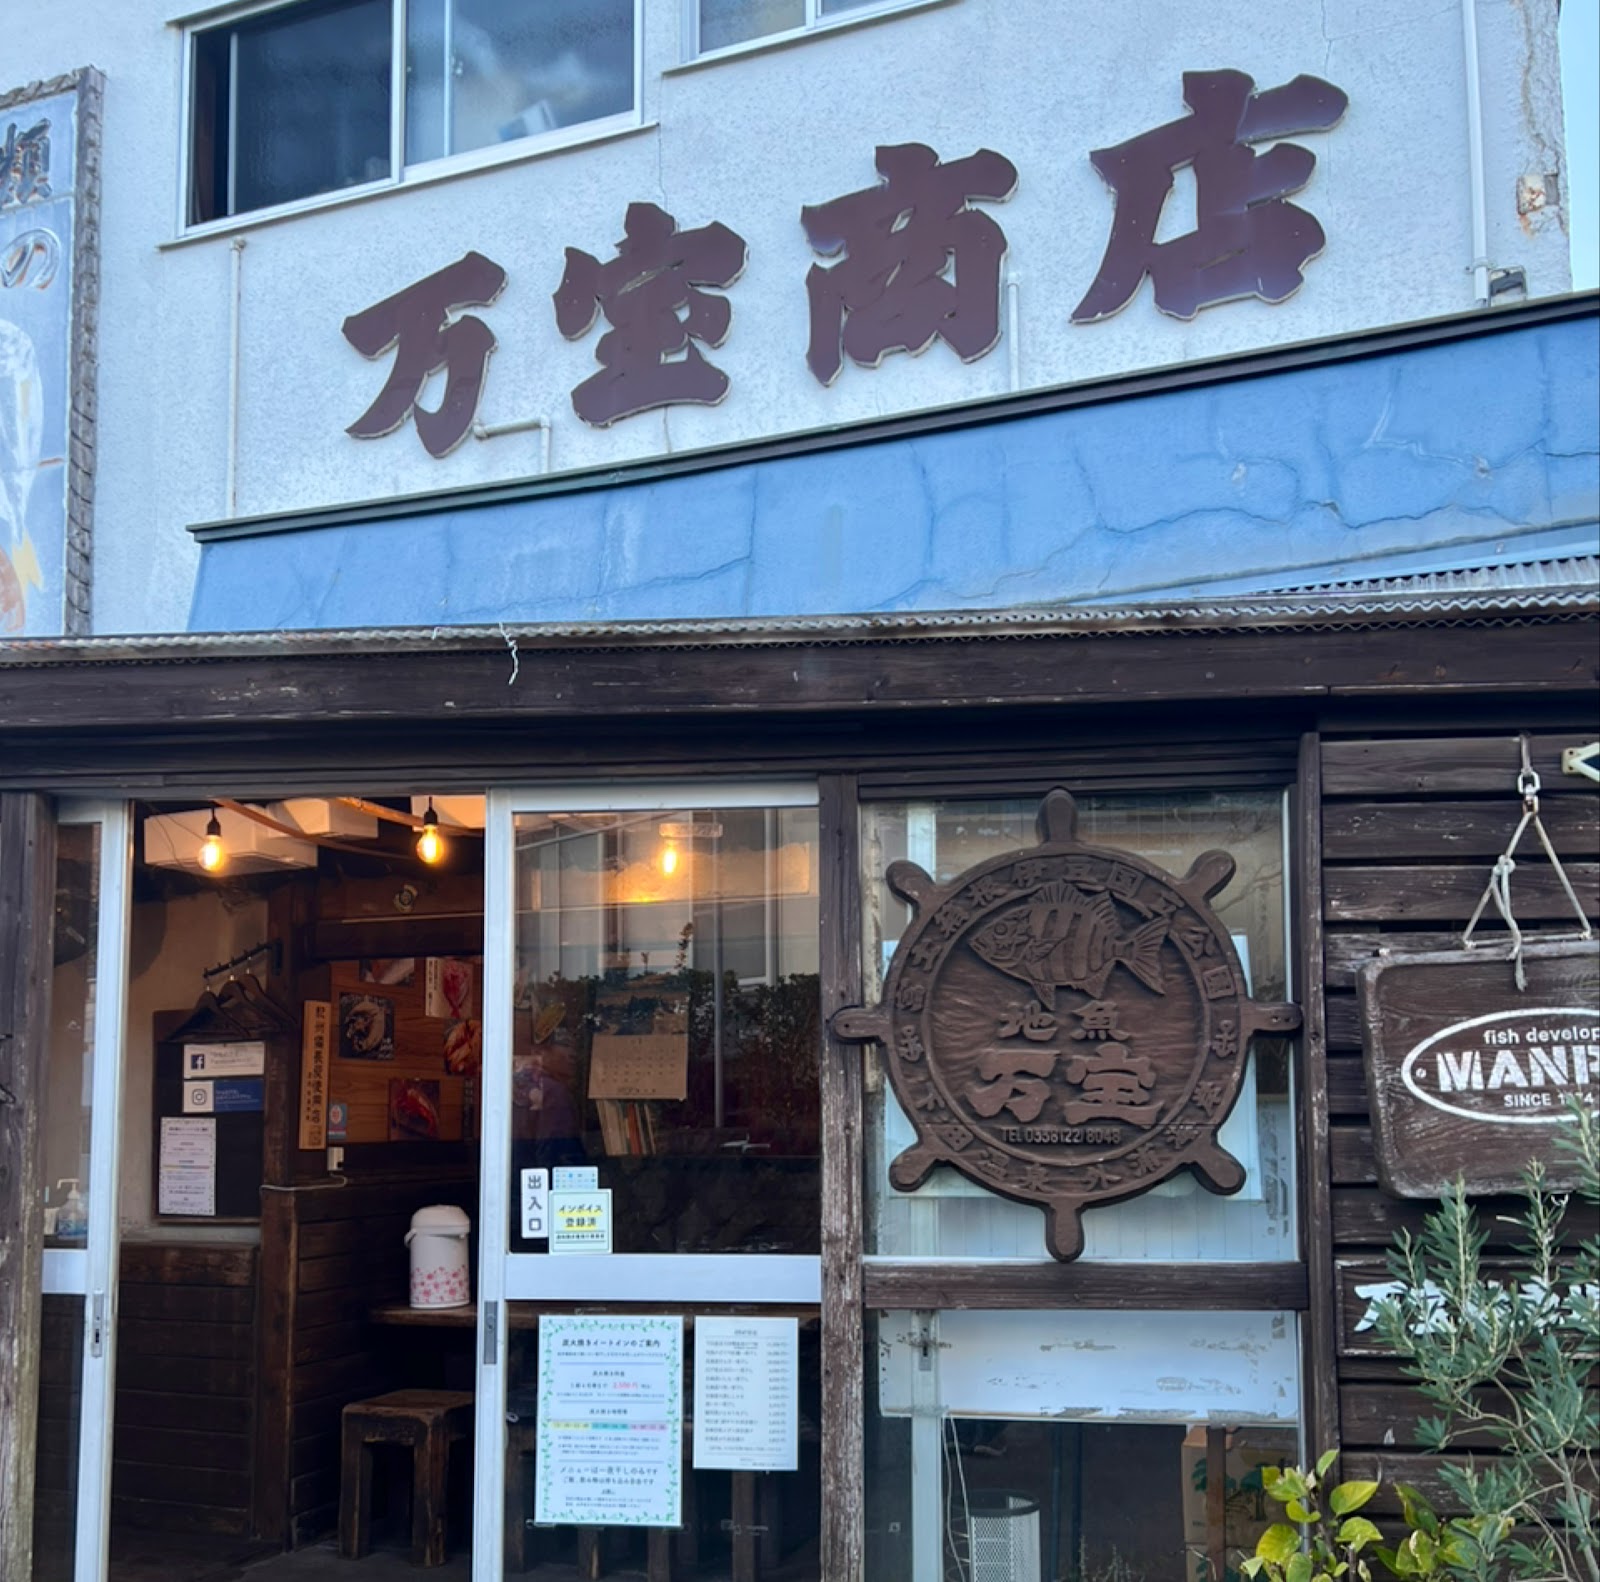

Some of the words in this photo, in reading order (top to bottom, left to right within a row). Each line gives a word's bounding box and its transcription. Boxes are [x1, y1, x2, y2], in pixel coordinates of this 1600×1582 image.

[343, 69, 1348, 457] 万宝商店
[999, 1000, 1131, 1041] 地魚
[1483, 1029, 1520, 1045] fish
[965, 1041, 1165, 1130] 万宝
[1503, 1093, 1552, 1108] SINCE
[527, 1175, 542, 1232] 出入口
[558, 1203, 603, 1213] インボイス
[565, 1217, 597, 1228] 登録済
